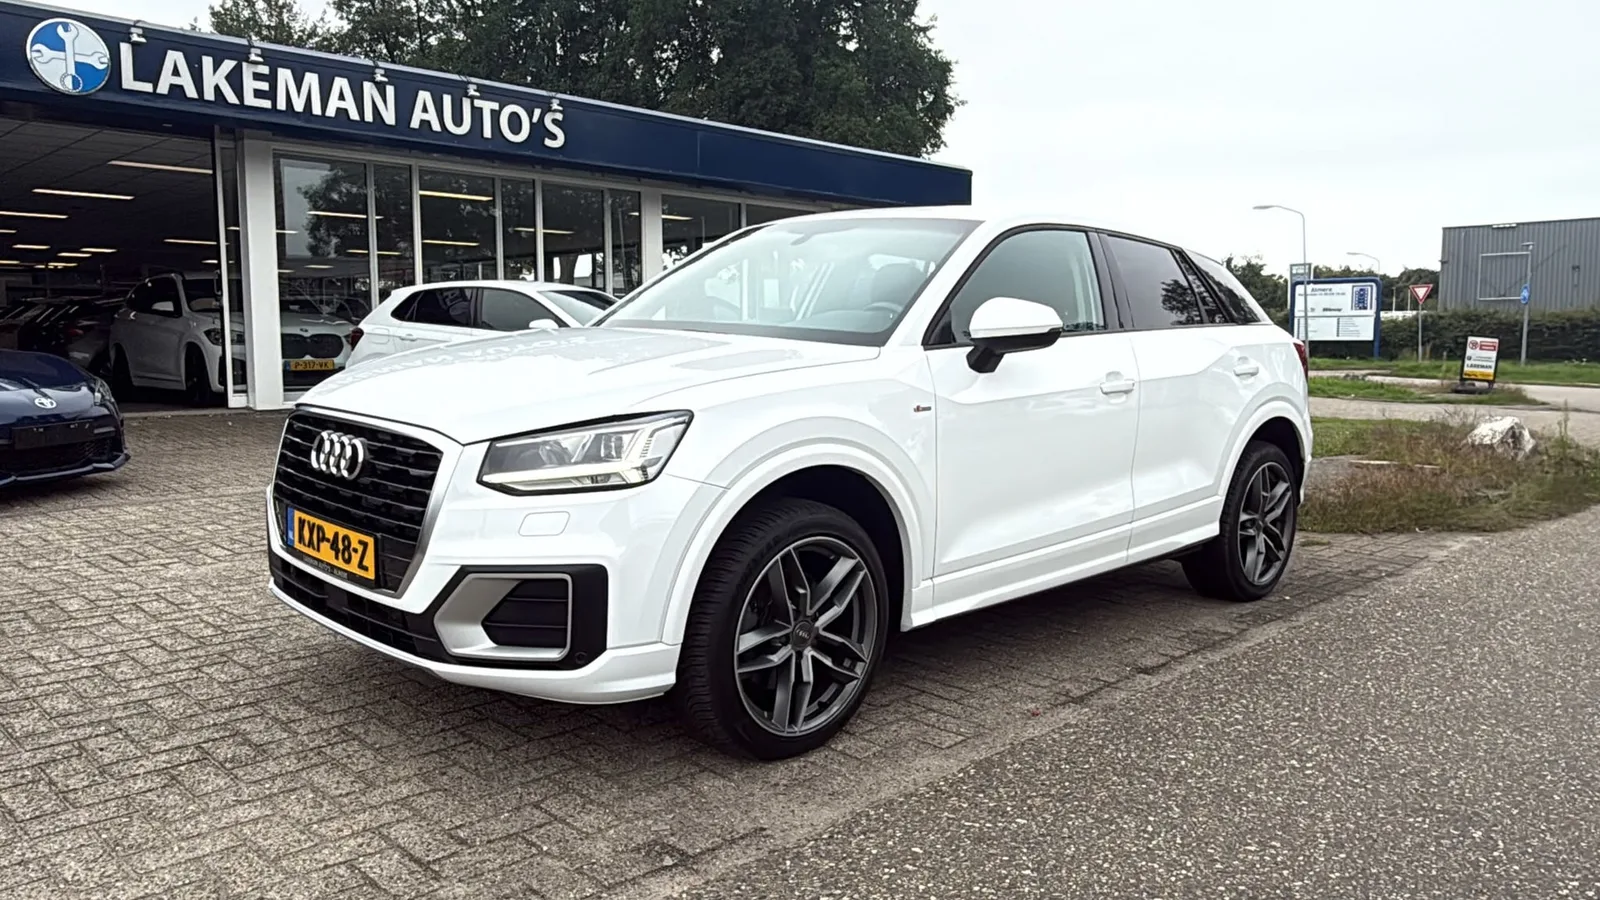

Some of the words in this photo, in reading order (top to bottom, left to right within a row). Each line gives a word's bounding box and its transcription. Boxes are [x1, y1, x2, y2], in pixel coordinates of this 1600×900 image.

[120, 42, 396, 126] LAKEMAN
[409, 90, 566, 149] AUTO'S
[294, 361, 330, 370] P-317-VK
[298, 516, 369, 572] KXP-48-Z
